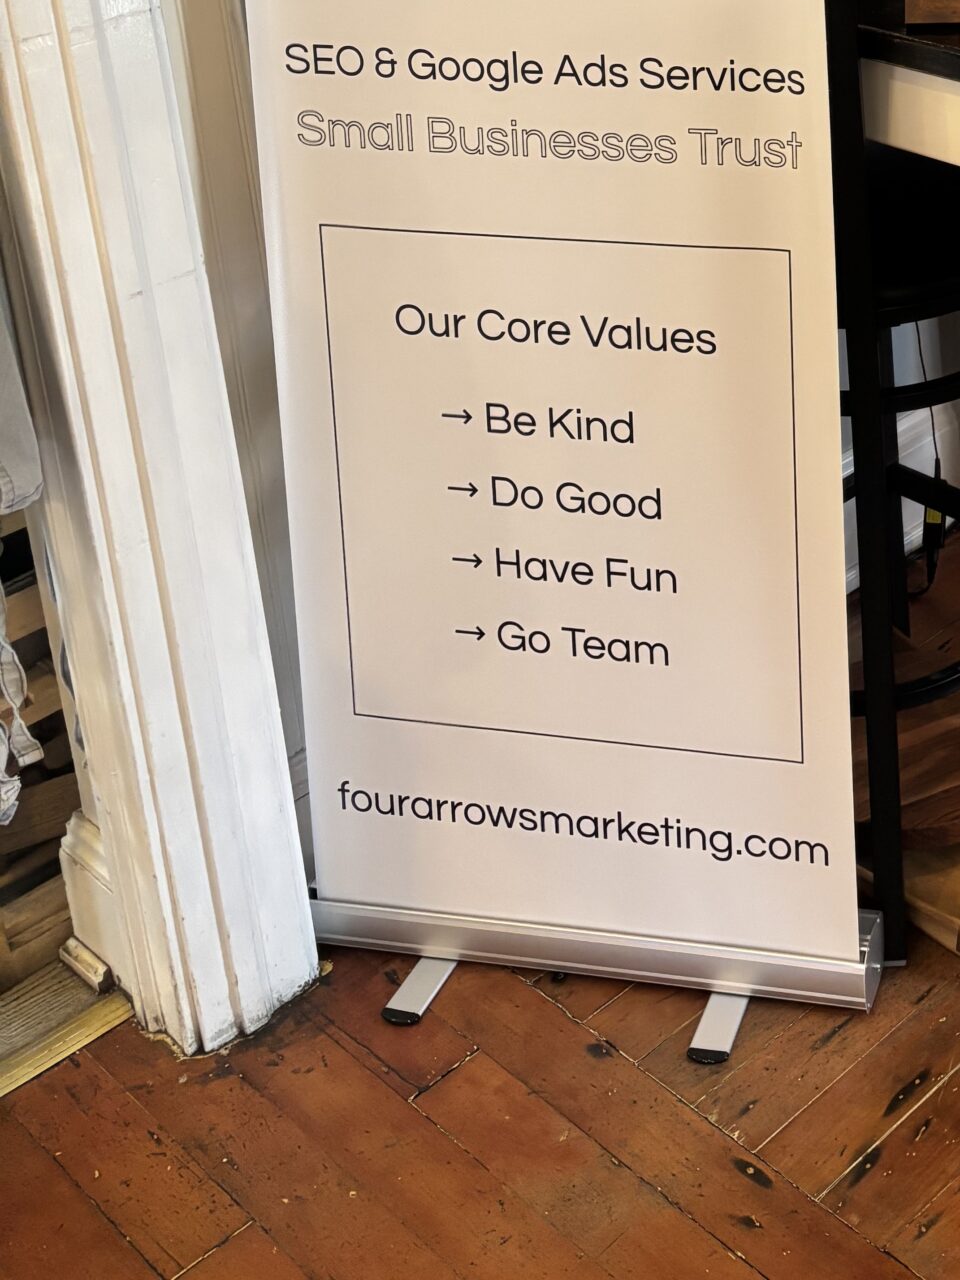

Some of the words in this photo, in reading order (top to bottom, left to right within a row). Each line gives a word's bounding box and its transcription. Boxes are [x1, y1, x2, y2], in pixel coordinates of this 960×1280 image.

[284, 42, 364, 77] SEO
[375, 47, 398, 78] &
[407, 48, 544, 92] Google
[553, 54, 628, 89] Ads
[639, 57, 806, 96] Services
[297, 110, 414, 152] Small
[427, 116, 678, 165] Businesses
[688, 128, 803, 170] Trust
[395, 303, 466, 339] Our
[476, 309, 571, 345] Core
[579, 314, 717, 355] Values
[485, 402, 537, 436] Be
[548, 407, 635, 444] Kind
[490, 475, 544, 510] Do
[555, 482, 662, 520] Good
[495, 547, 594, 585] Have
[605, 557, 678, 594] Fun
[497, 620, 551, 654] Go
[561, 626, 670, 666] Team
[337, 780, 830, 867] fourarrowsmarketing.com
